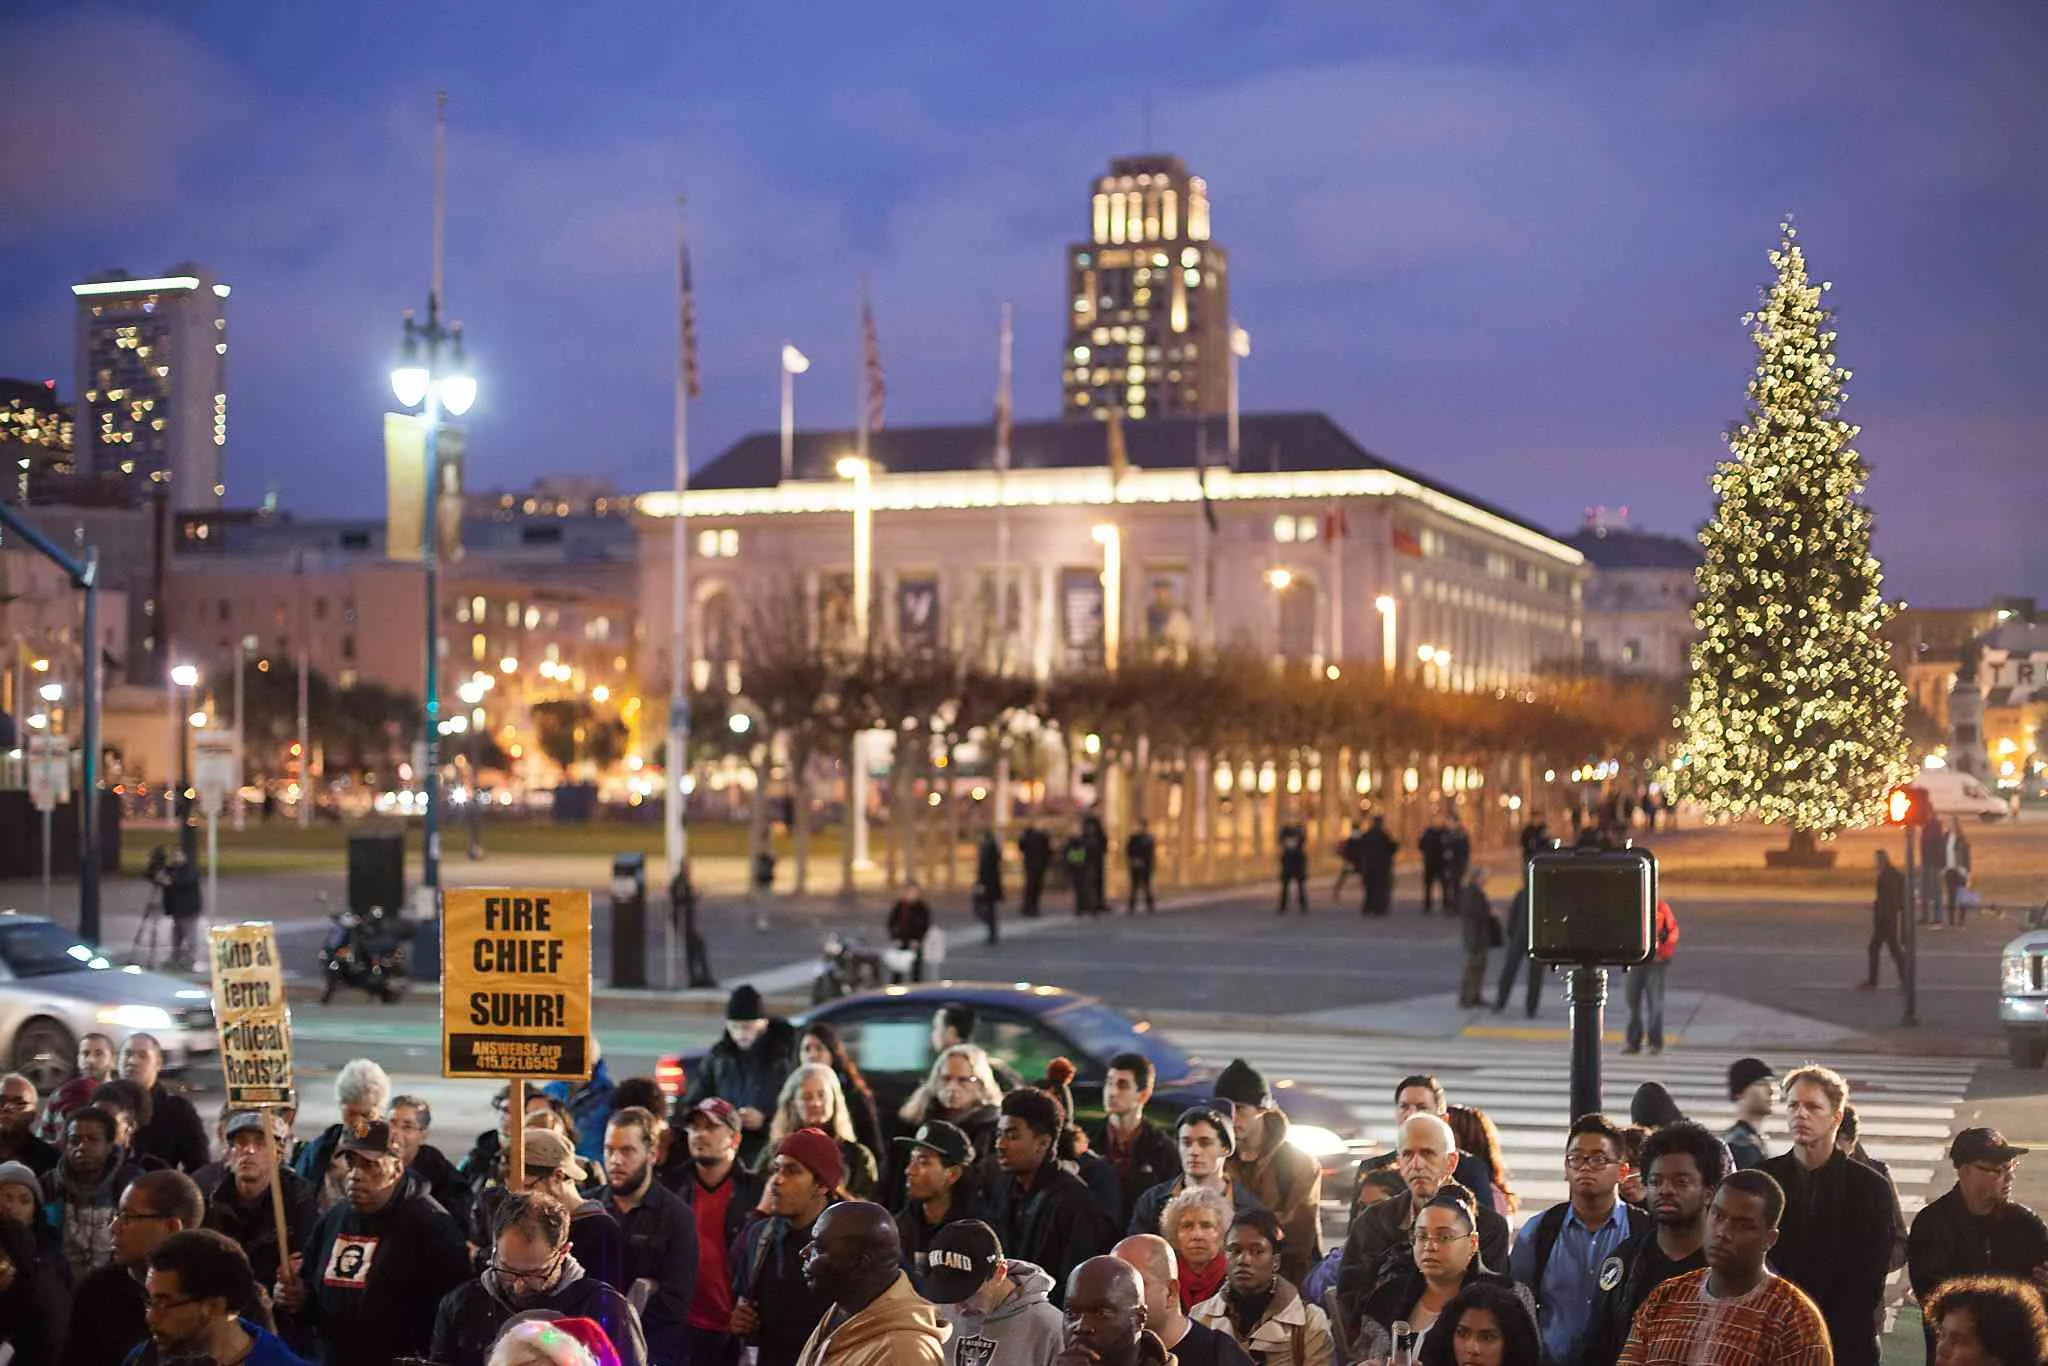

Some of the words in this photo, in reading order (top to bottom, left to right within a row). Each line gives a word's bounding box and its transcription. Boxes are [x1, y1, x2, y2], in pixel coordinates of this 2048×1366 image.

[1988, 661, 2048, 686] TR
[485, 897, 551, 932] FIRE
[256, 935, 272, 967] al
[473, 938, 564, 974] CHIEF
[222, 978, 271, 1009] Terror
[470, 992, 566, 1028] SUHR!
[223, 1019, 284, 1051] Policial
[225, 1053, 288, 1085] Racista!
